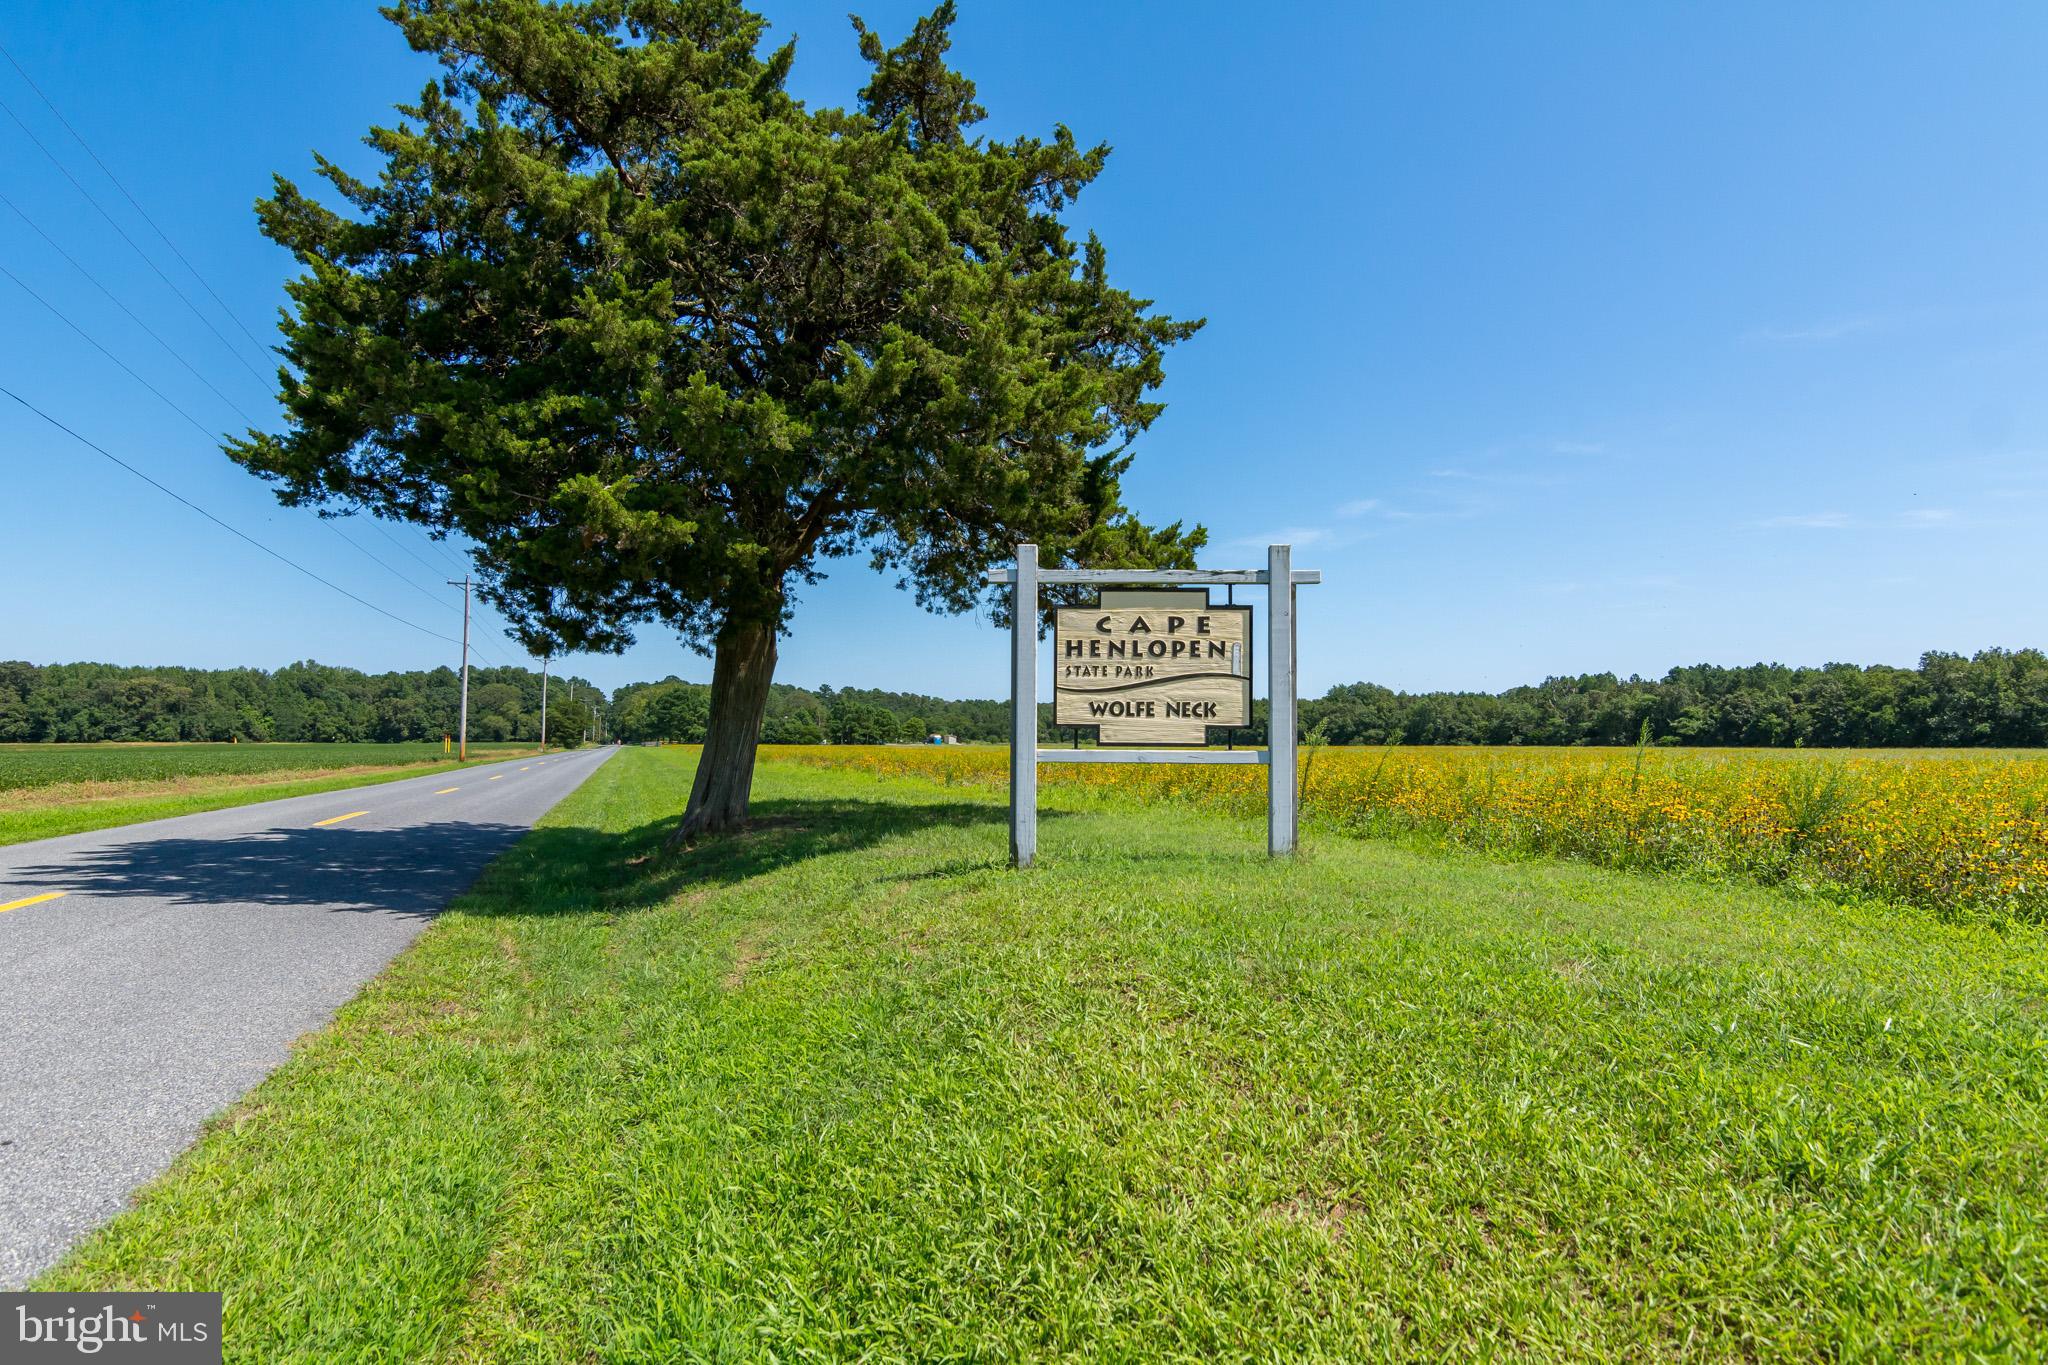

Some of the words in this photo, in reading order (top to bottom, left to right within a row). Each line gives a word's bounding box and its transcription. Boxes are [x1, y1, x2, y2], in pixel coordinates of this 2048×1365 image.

[1096, 615, 1211, 634] CAPE
[1065, 639, 1226, 658] HENLOPEN
[1065, 665, 1108, 678] STATE
[1115, 665, 1154, 678] PARK
[1088, 701, 1155, 717] WOLFE
[1165, 701, 1217, 718] NECK
